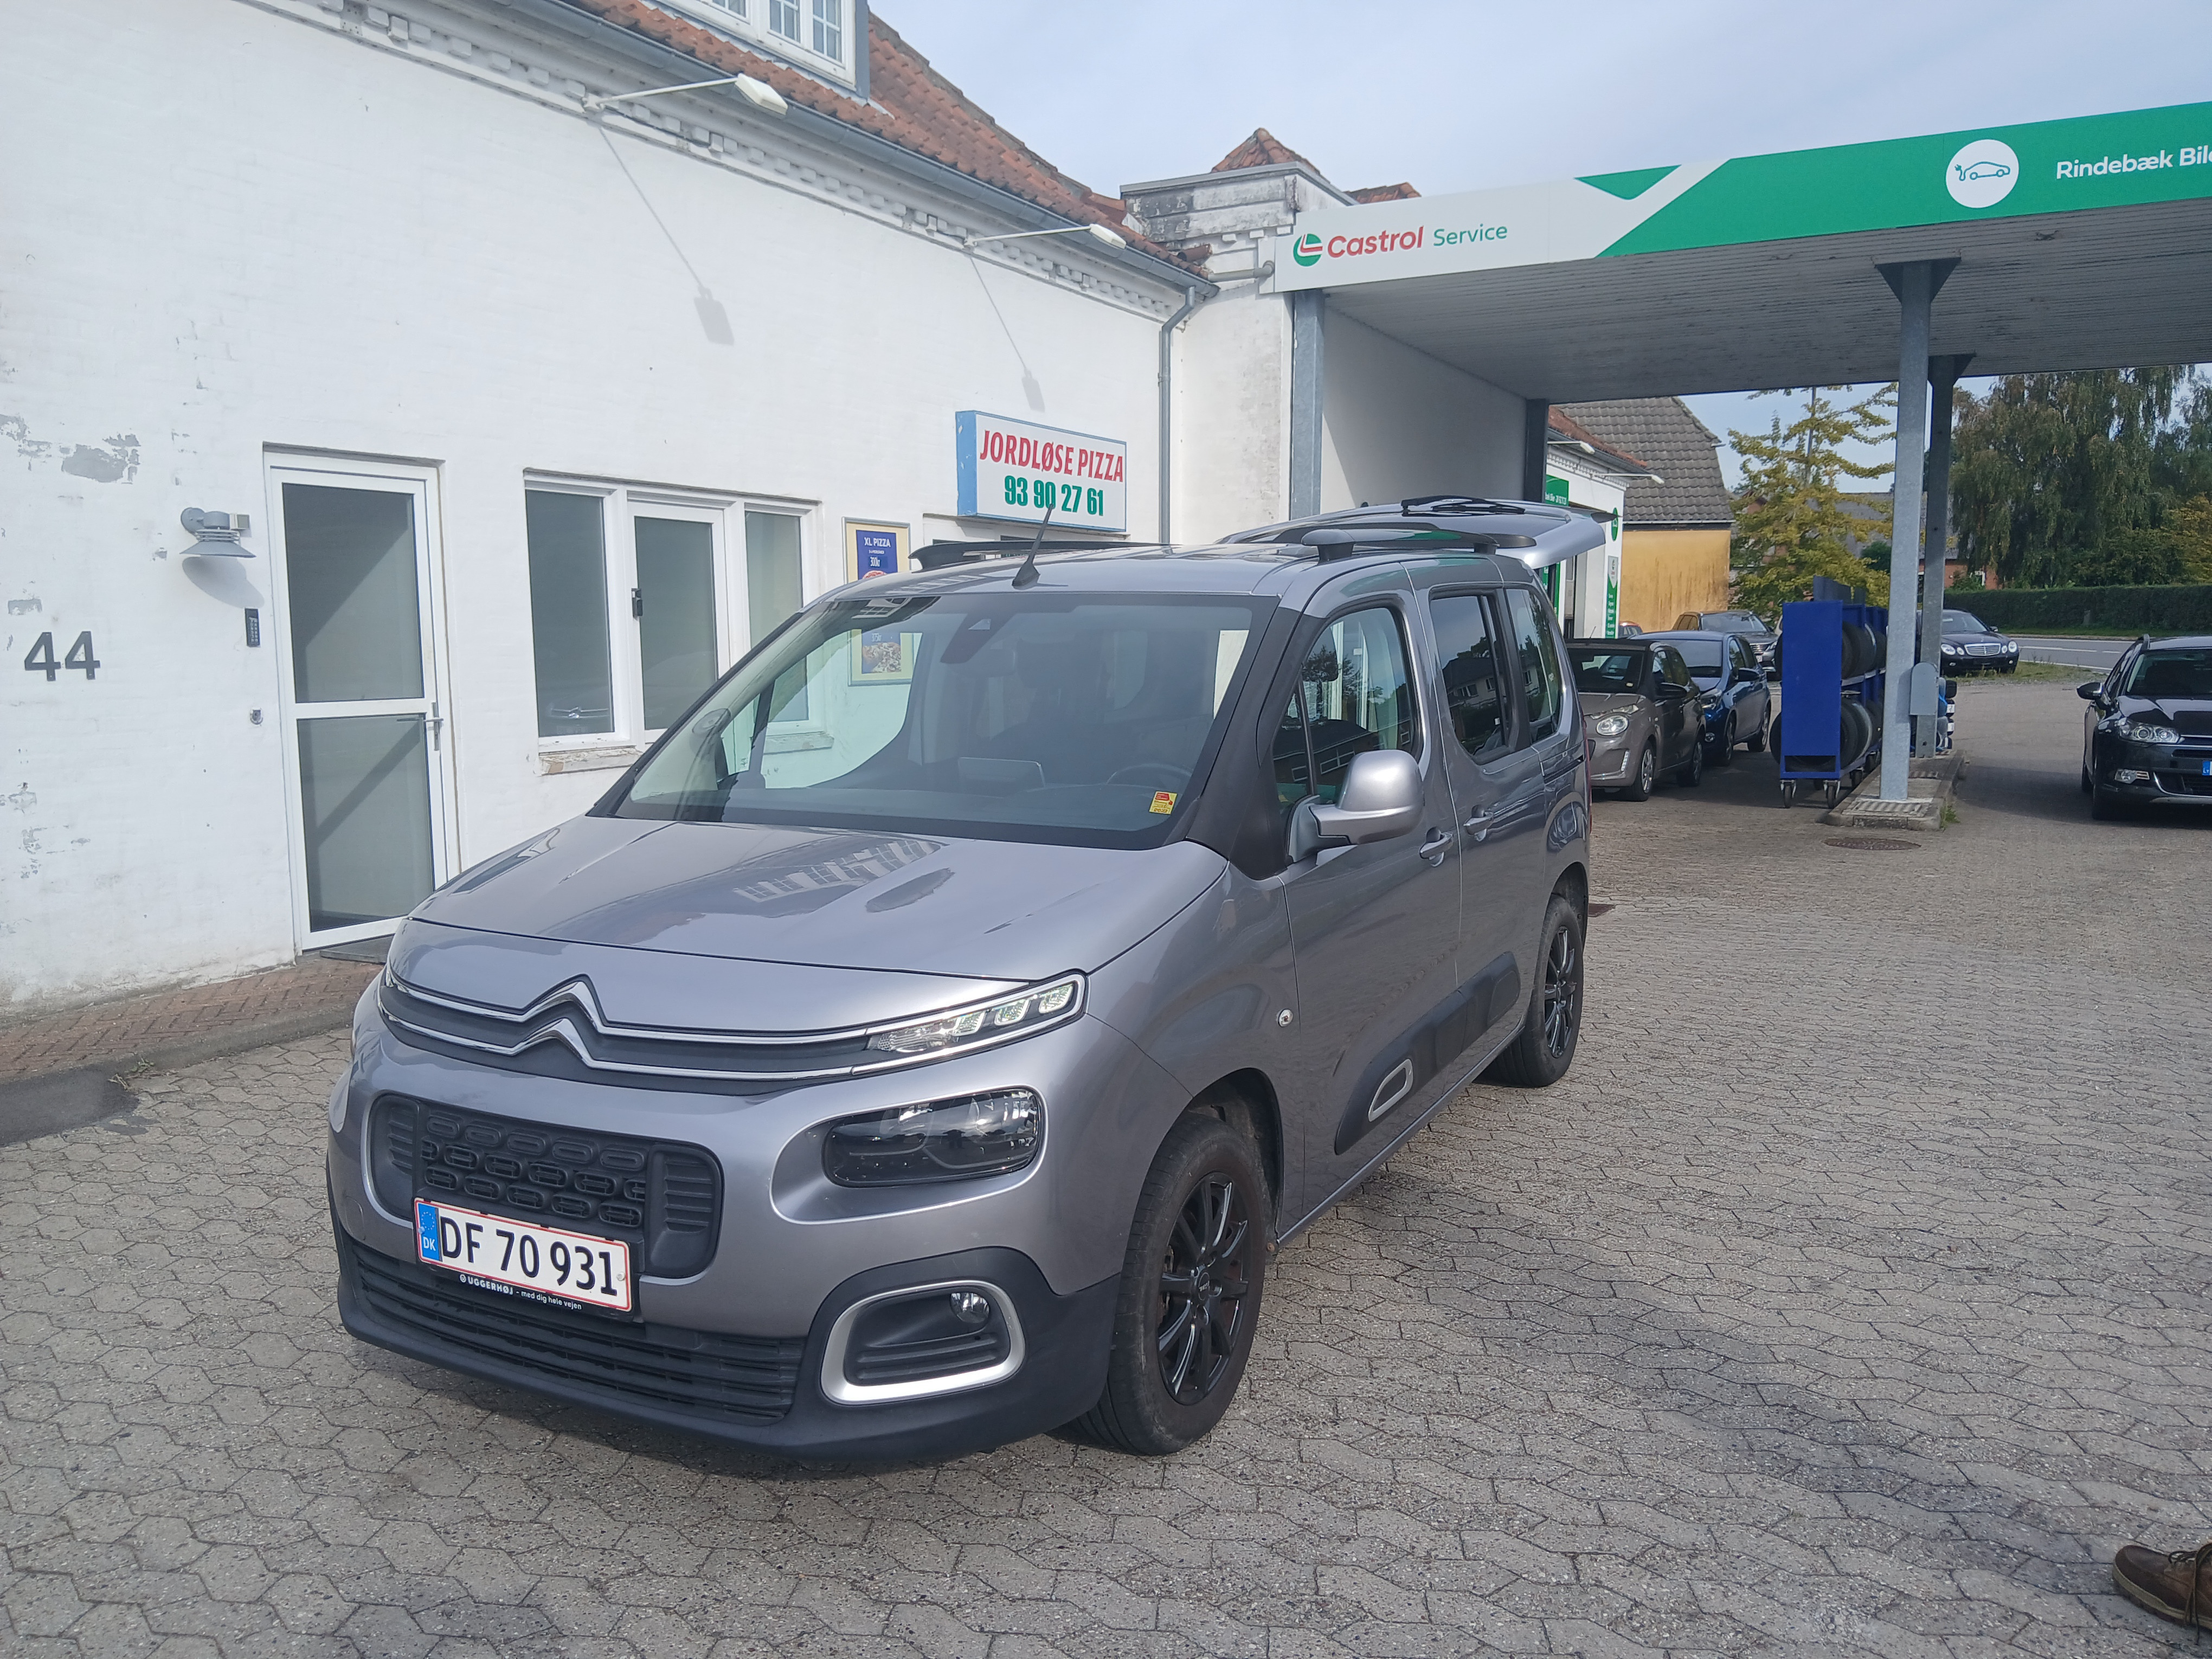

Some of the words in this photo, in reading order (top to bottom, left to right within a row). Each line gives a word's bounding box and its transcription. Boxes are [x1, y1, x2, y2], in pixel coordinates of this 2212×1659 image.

[2056, 150, 2174, 179] Rindebæk
[2179, 145, 2212, 166] Bil
[1327, 225, 1424, 258] Castrol
[1433, 223, 1508, 247] Service
[979, 429, 1074, 475] JORDLØSE
[1077, 448, 1123, 483] PIZZA
[1004, 475, 1028, 506] 93
[1033, 480, 1056, 510] 90
[1061, 484, 1082, 512] 27
[1087, 487, 1104, 516] 61
[864, 537, 872, 546] XL
[873, 537, 891, 548] PIZZA
[24, 631, 101, 682] 44
[423, 1236, 436, 1252] DK
[440, 1216, 484, 1263] DF
[496, 1229, 540, 1278] 70
[550, 1240, 618, 1297] 931
[467, 1276, 513, 1295] UGGERHØJ
[521, 1290, 535, 1300] med
[536, 1294, 547, 1304] dig
[563, 1301, 582, 1310] vejen
